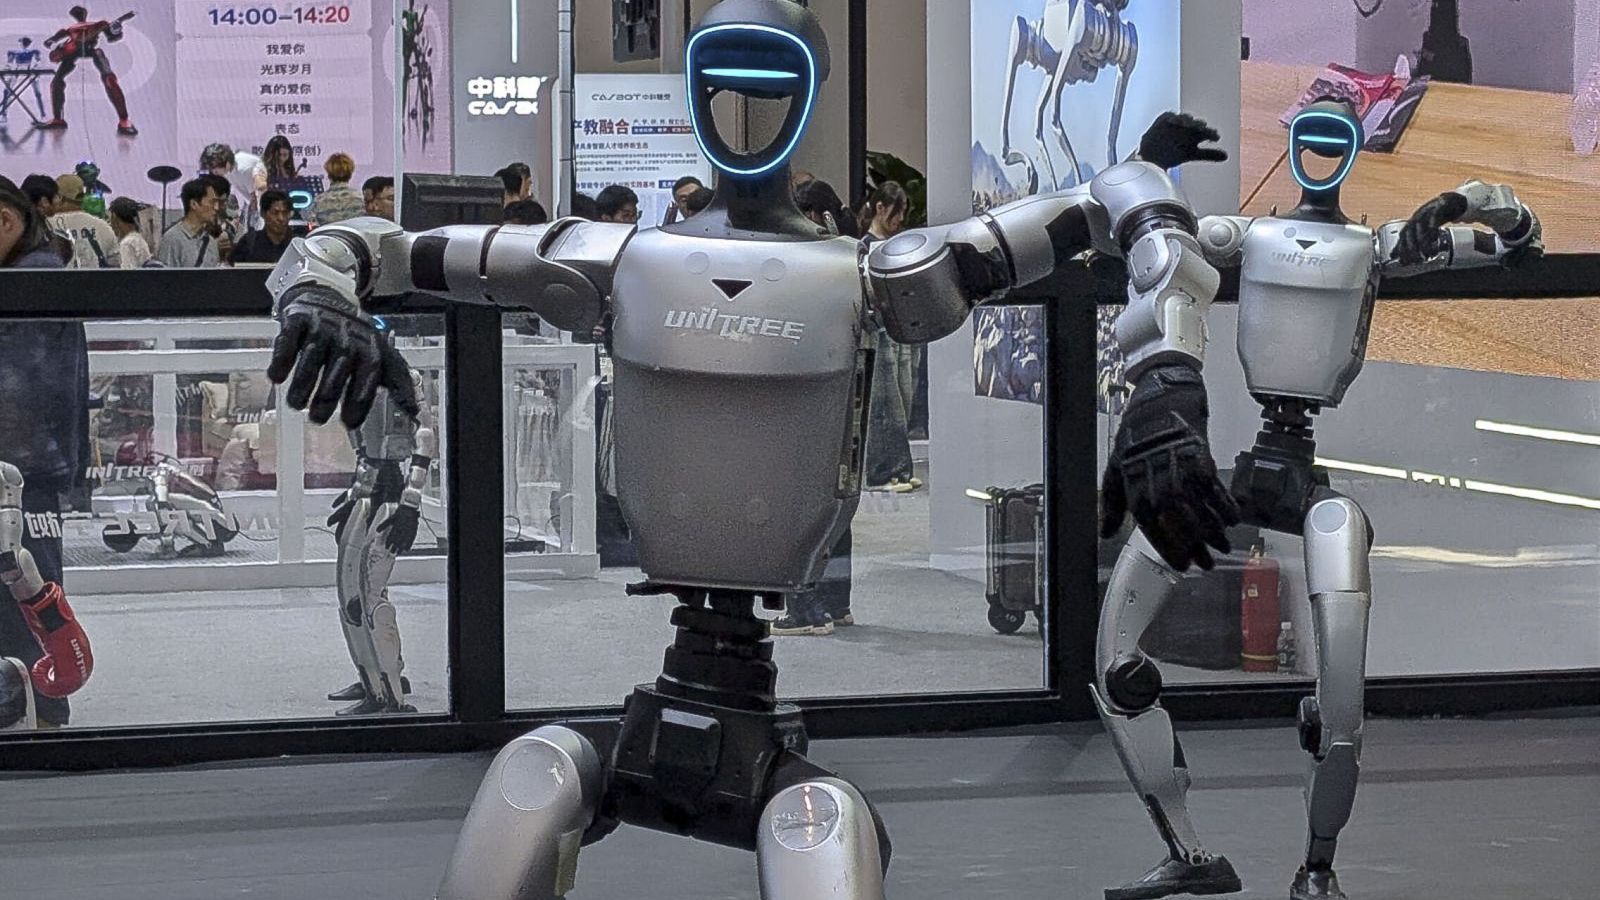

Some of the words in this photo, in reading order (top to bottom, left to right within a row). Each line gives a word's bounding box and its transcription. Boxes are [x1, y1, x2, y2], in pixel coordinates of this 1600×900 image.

[266, 44, 306, 55] 我爱你
[260, 63, 312, 76] 光辉岁月
[260, 83, 312, 95] 真的爱你
[467, 76, 548, 98] 中科慧
[259, 103, 312, 115] 不再犹豫
[663, 307, 805, 341] UNITREE
